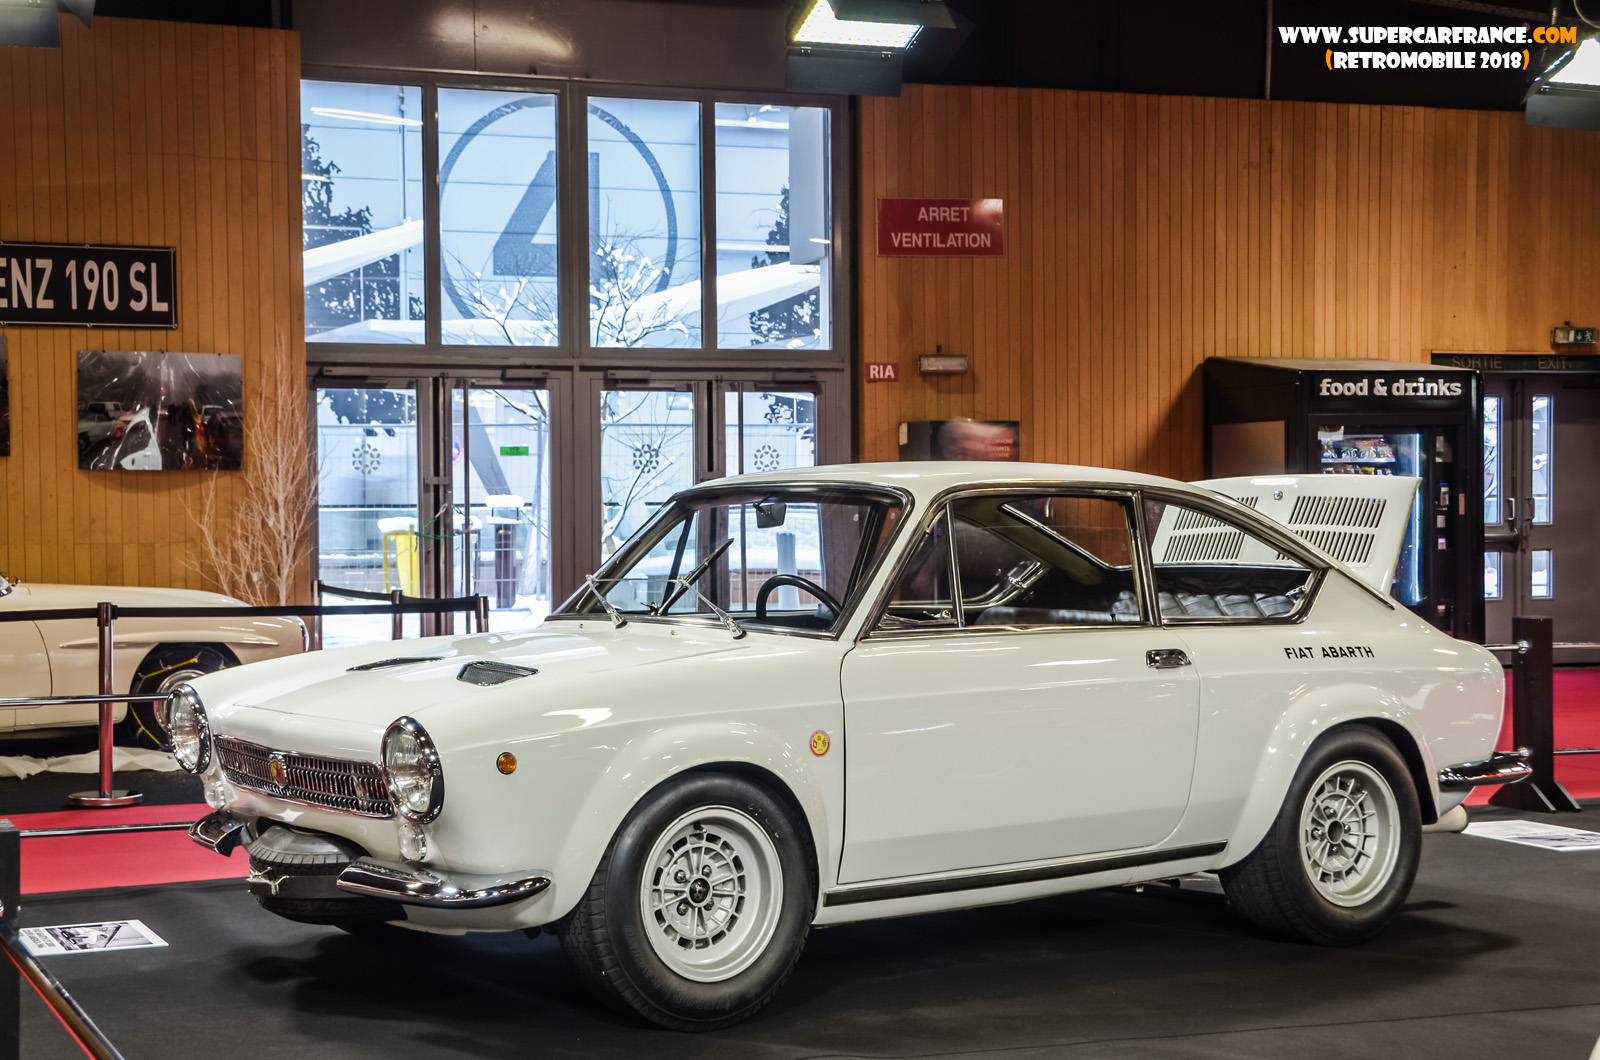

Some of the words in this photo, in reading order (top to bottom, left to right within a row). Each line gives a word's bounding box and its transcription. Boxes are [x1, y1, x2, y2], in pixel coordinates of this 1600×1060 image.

[917, 206, 971, 222] ARRET
[891, 232, 991, 248] VENTILATION
[65, 259, 119, 311] 190
[129, 261, 169, 312] SL
[1451, 355, 1503, 369] SORTIE
[1538, 356, 1568, 370] EXIT
[869, 364, 895, 379] RIA
[1319, 378, 1368, 396] food
[1373, 378, 1388, 396] &
[1391, 377, 1462, 396] drinks
[1284, 647, 1314, 659] FIAT
[1321, 646, 1375, 658] ABARTH
